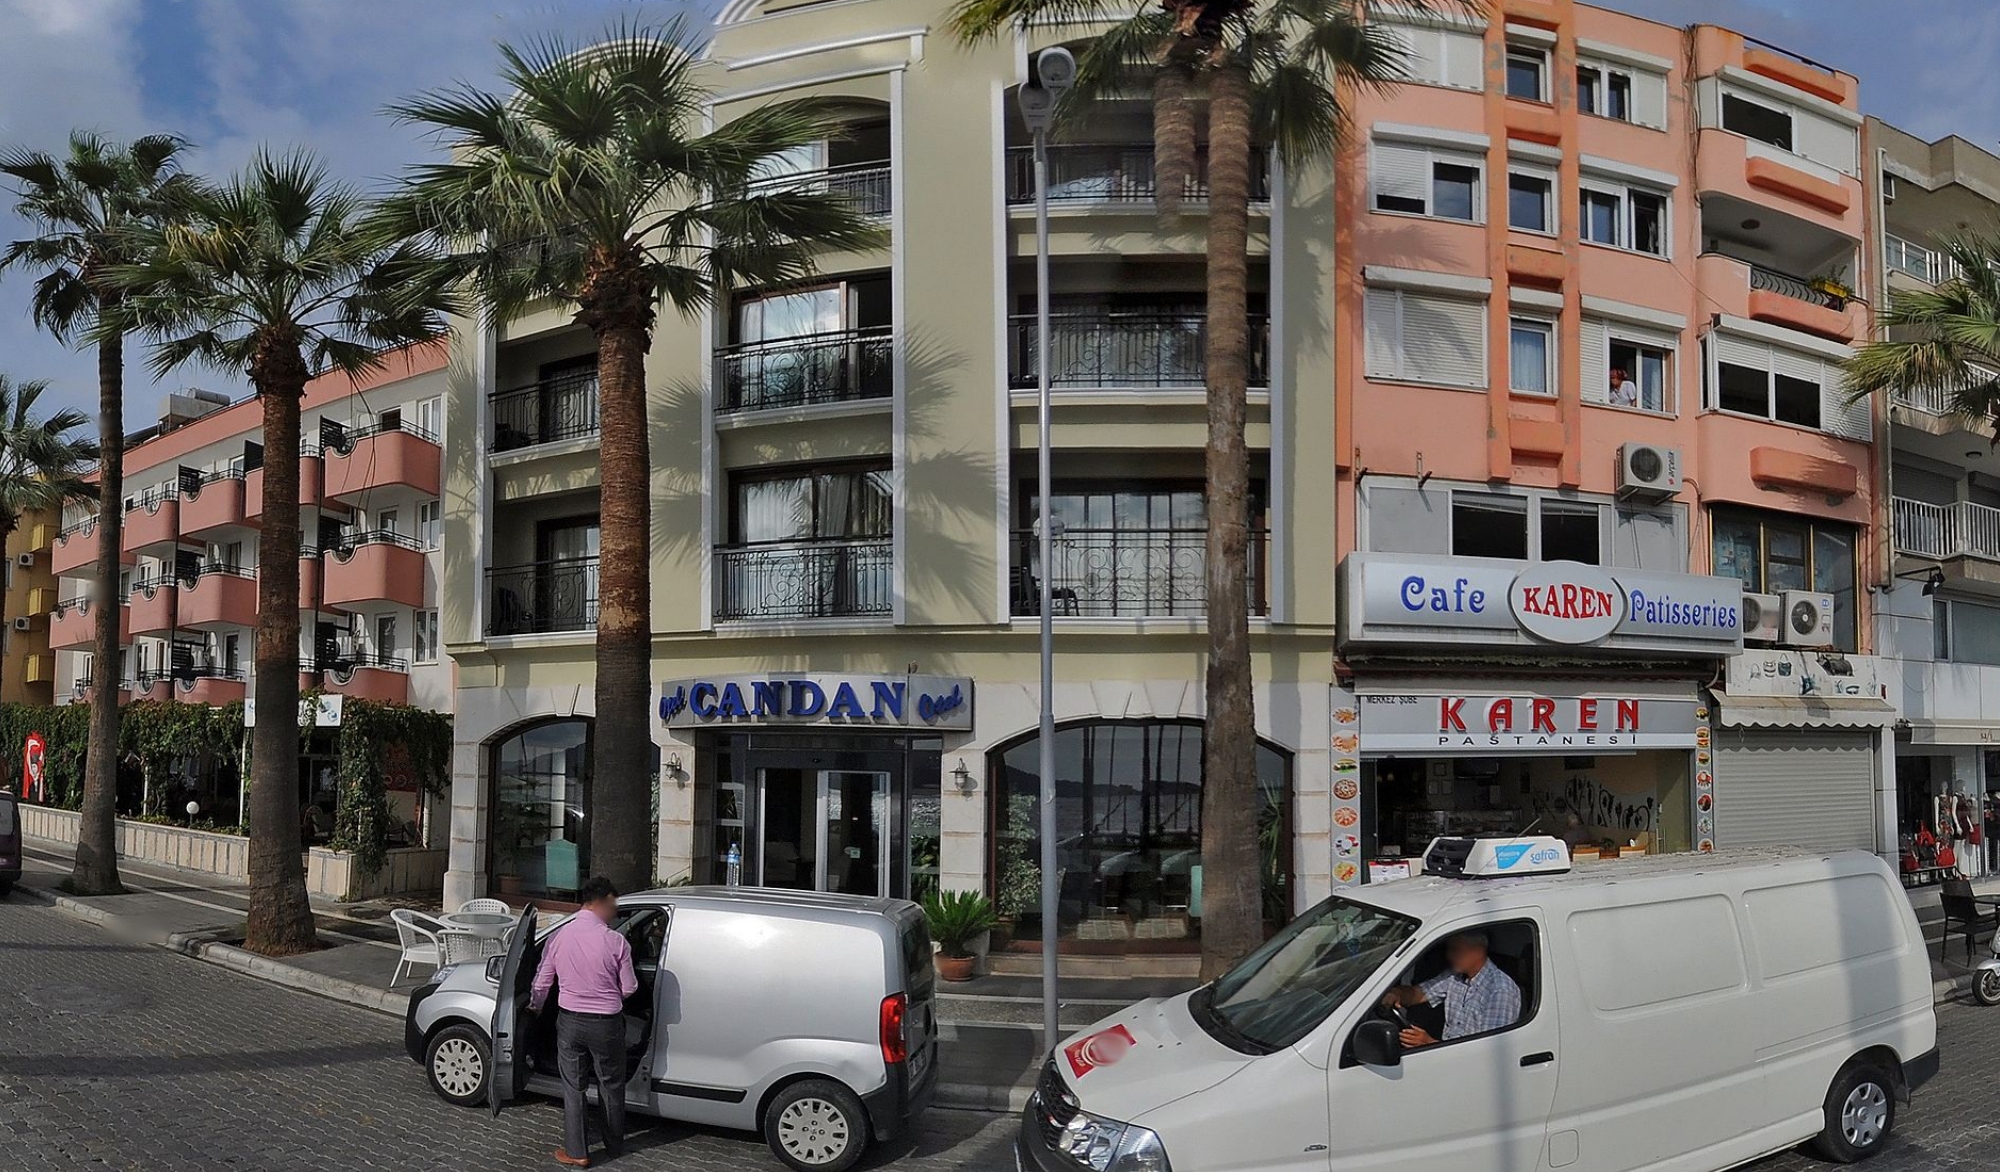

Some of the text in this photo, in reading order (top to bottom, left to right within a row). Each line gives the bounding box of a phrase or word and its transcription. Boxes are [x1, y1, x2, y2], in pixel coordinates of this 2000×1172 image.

[1400, 575, 1737, 629] Cafe KAREN Patisseries
[690, 680, 906, 717] CANDAN
[1440, 697, 1640, 733] KAREN
